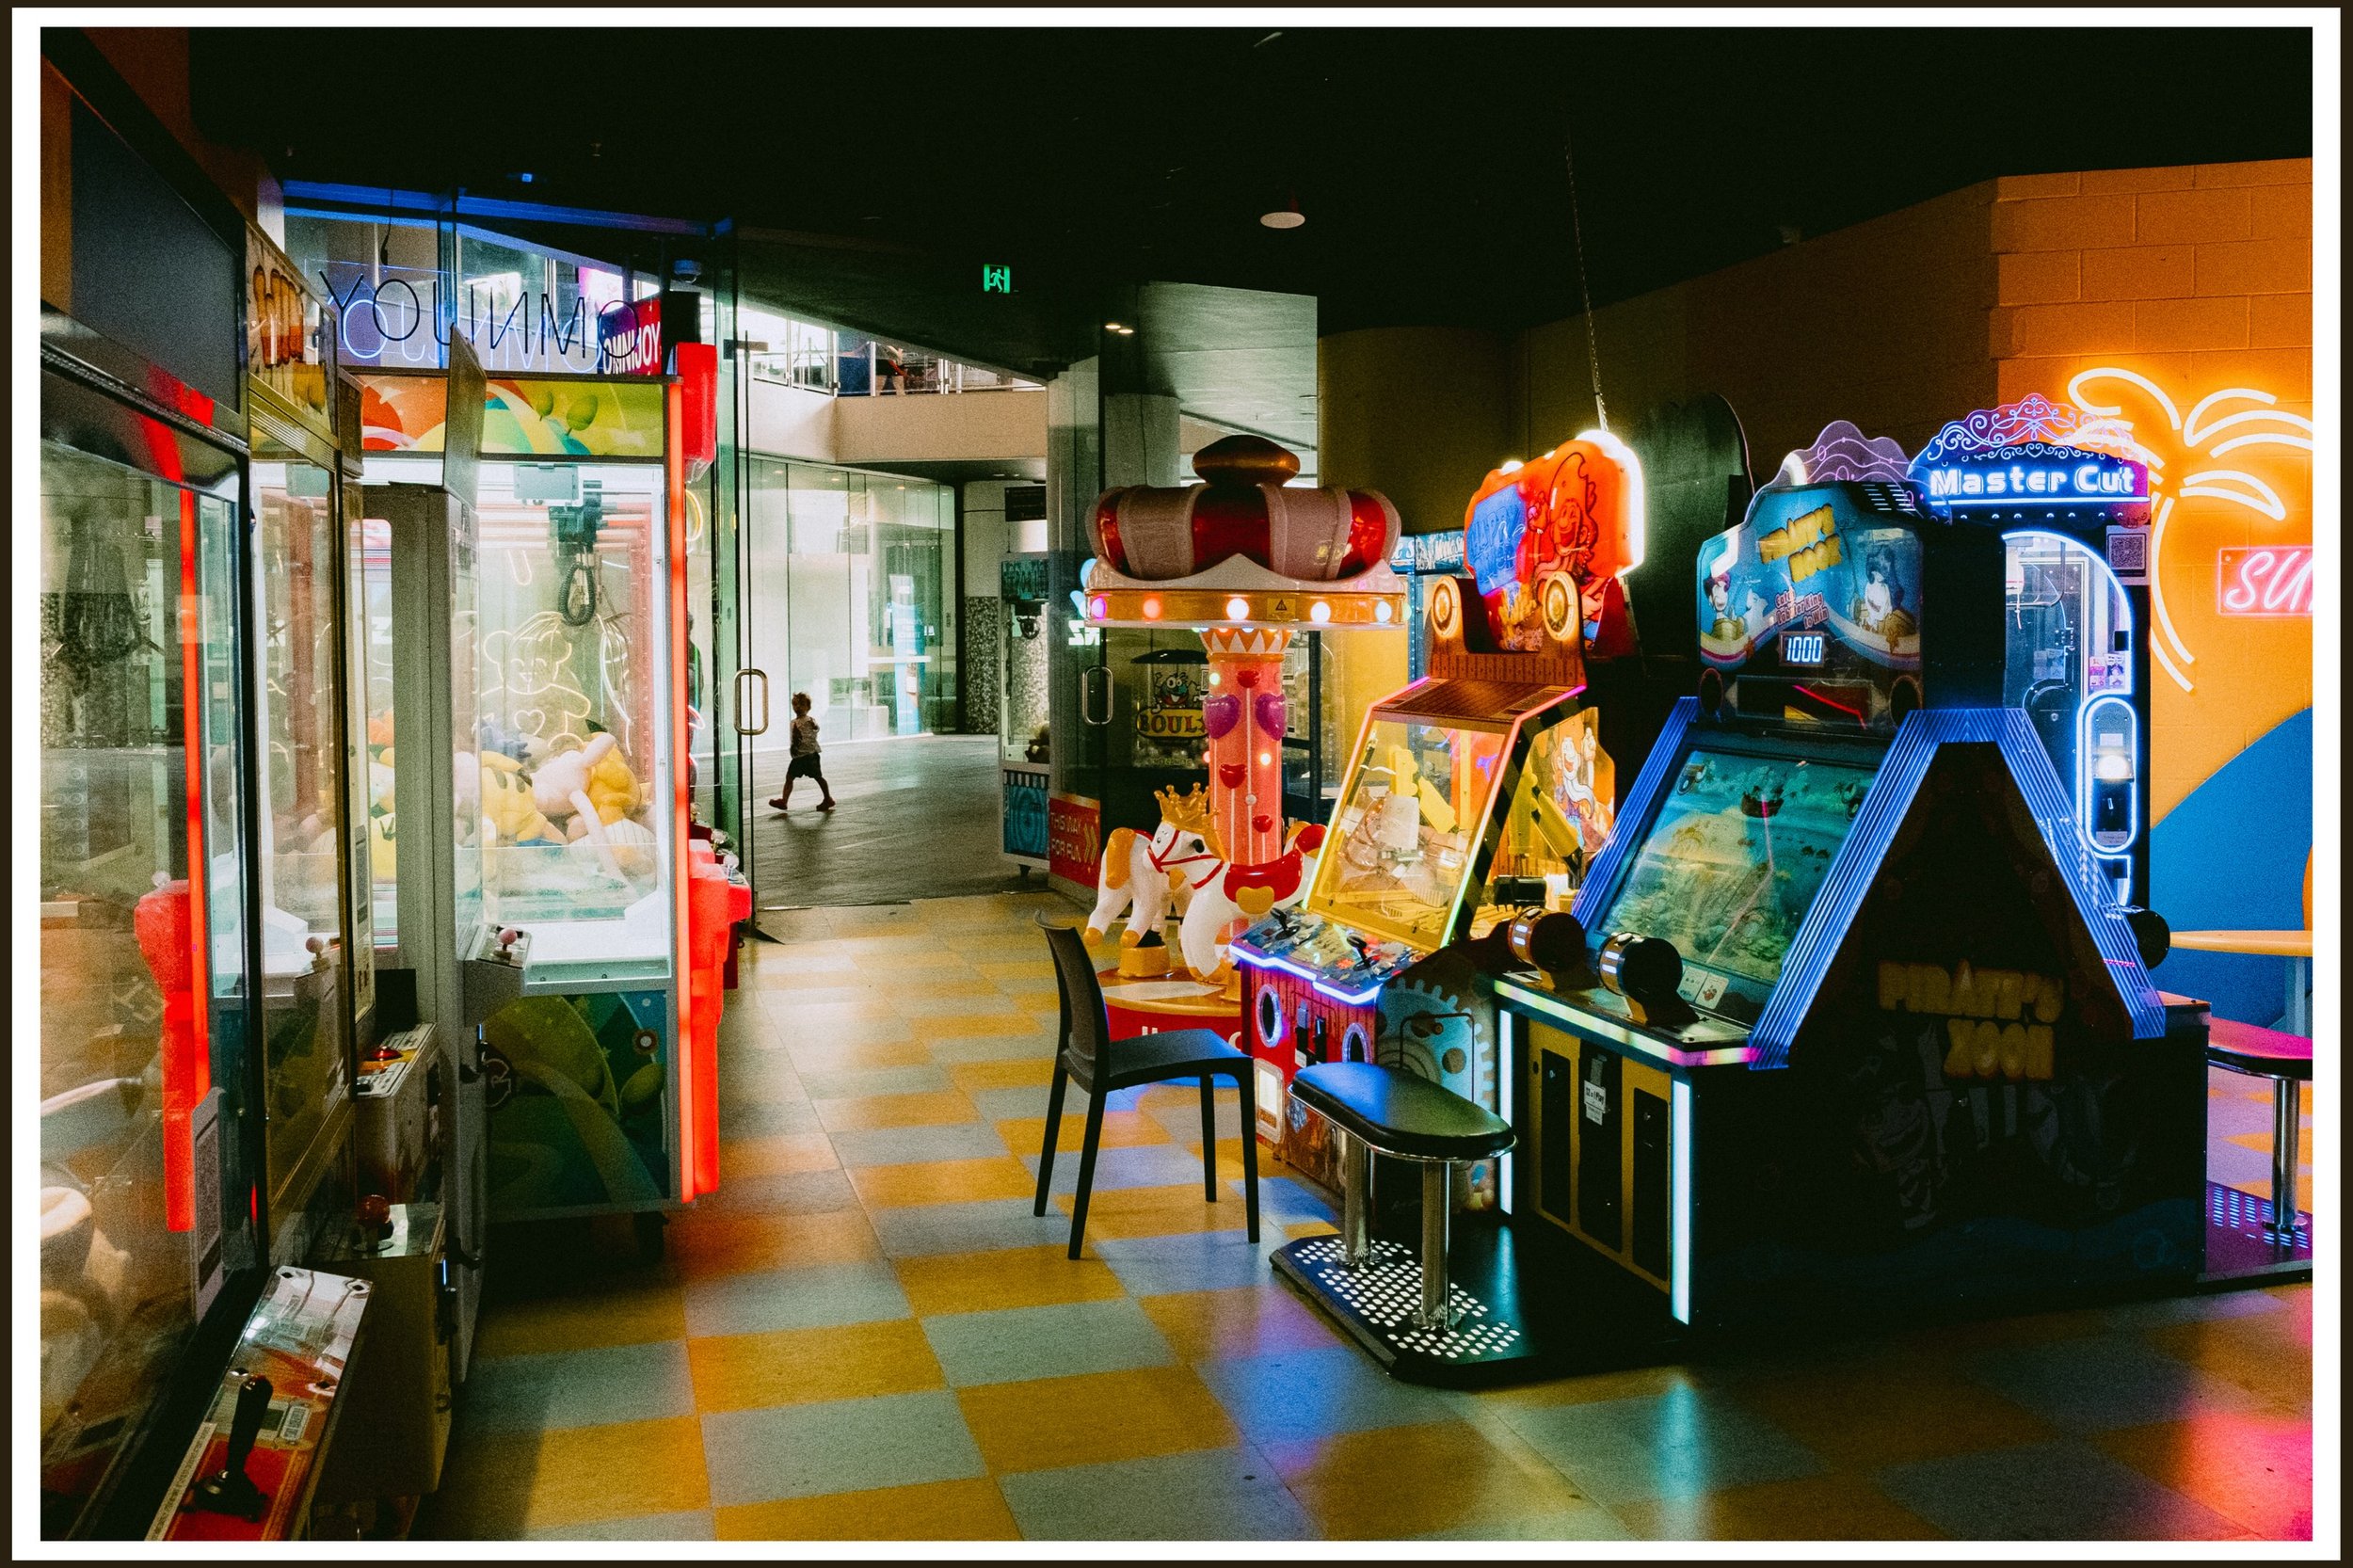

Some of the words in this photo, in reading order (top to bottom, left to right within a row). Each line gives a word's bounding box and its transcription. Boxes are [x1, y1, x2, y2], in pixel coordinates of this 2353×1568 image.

[603, 321, 660, 374] OMNIJOY
[1930, 466, 2067, 496] Master
[2074, 465, 2135, 494] Cut
[1786, 636, 1823, 662] 1000
